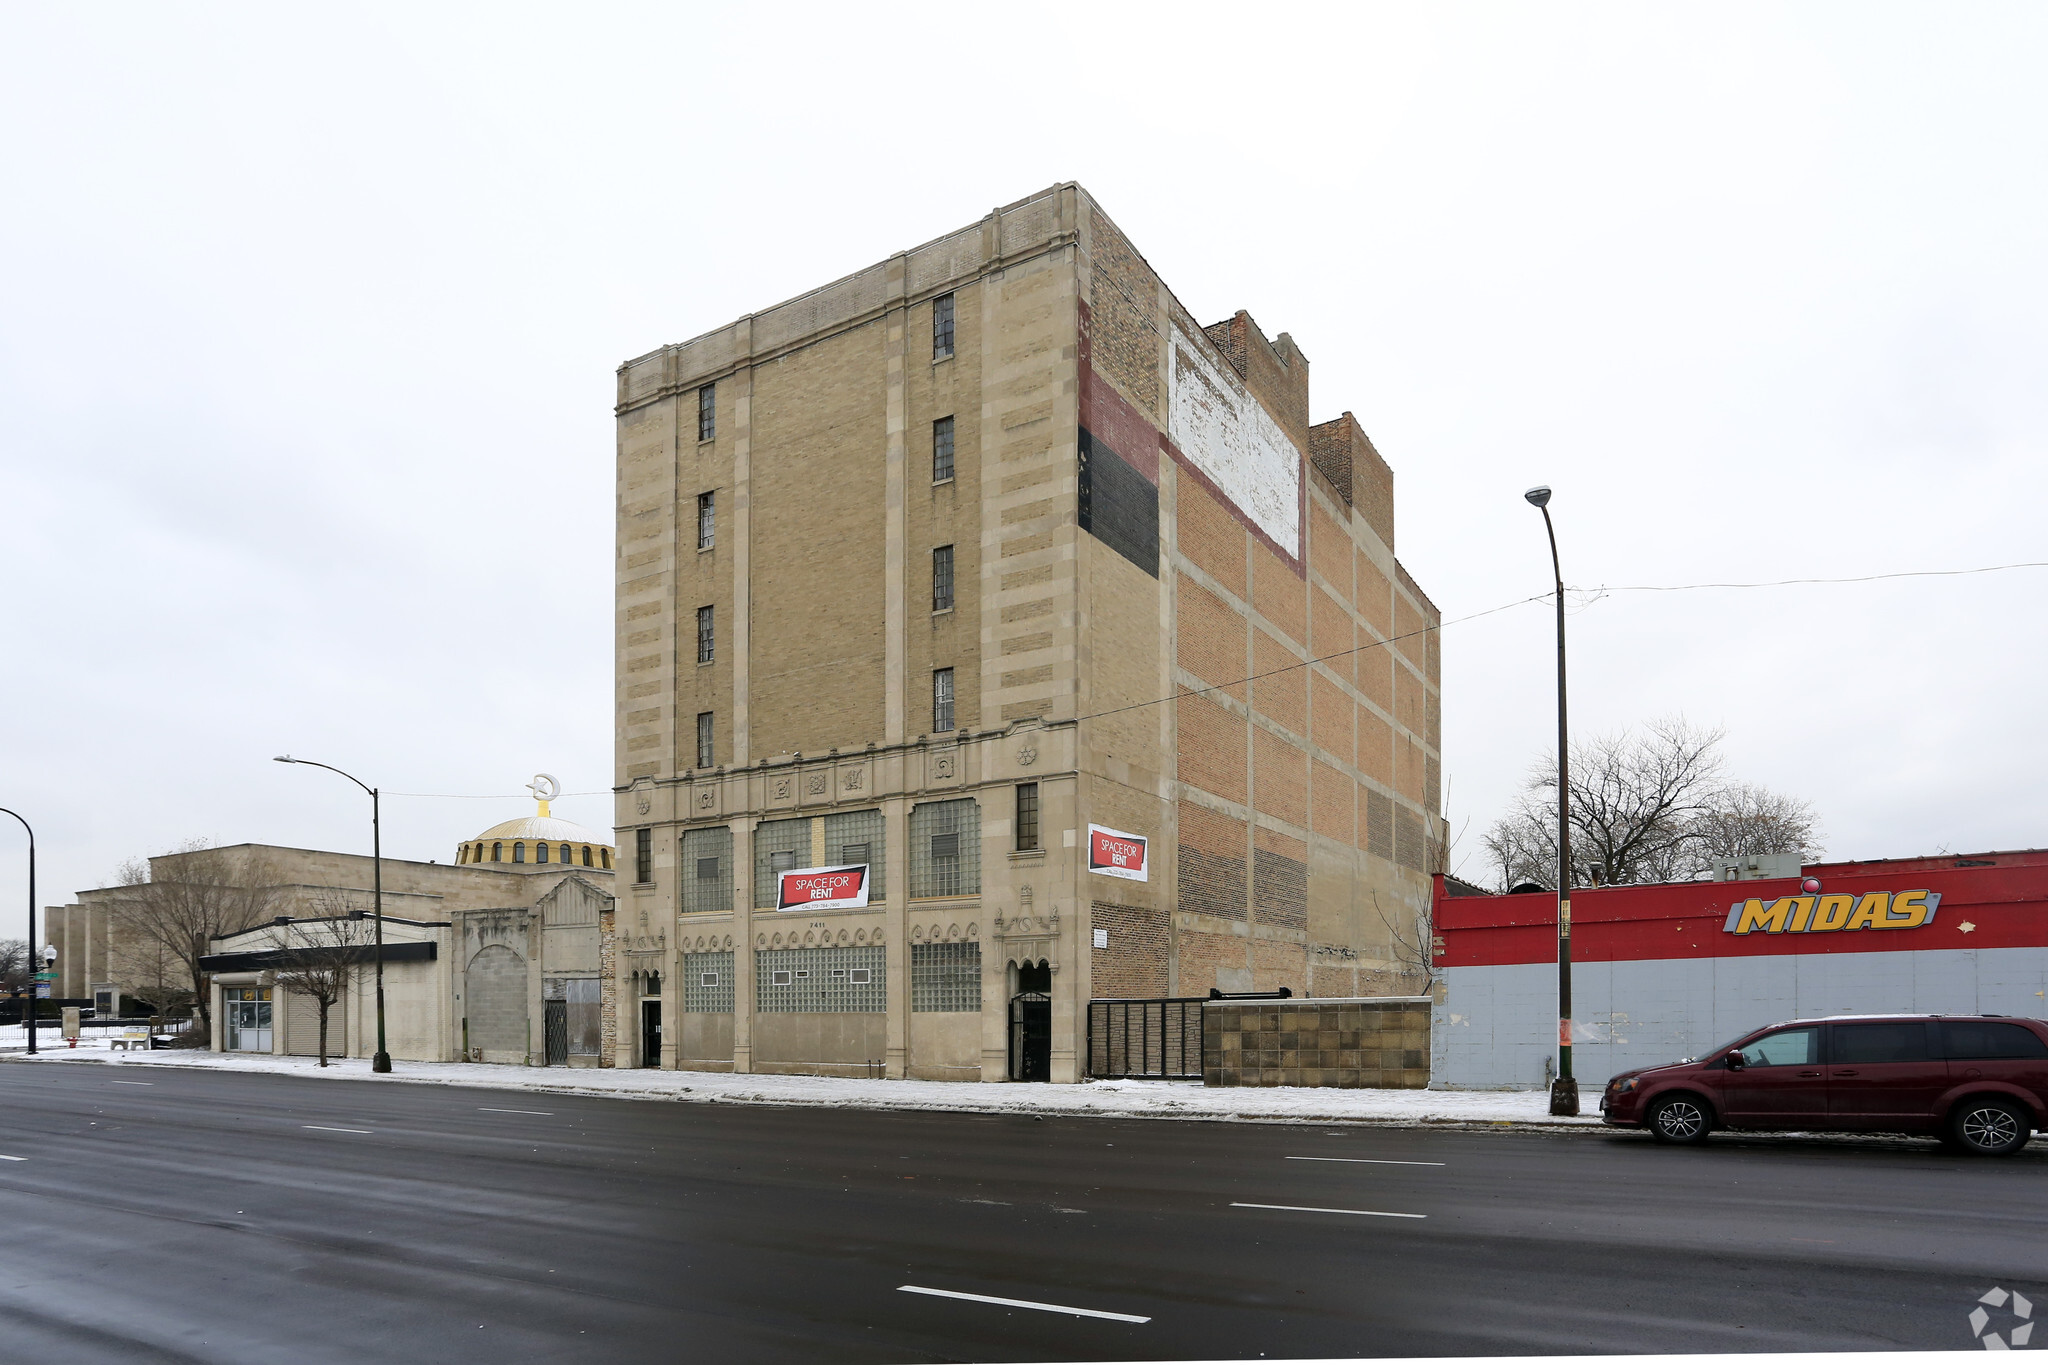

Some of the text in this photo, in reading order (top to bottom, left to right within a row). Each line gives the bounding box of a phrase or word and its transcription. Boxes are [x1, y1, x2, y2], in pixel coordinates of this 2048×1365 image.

[1101, 839, 1136, 857] SPACE FOR
[1112, 853, 1127, 866] RENT
[796, 876, 849, 890] SPACE FOR
[811, 888, 833, 899] RENT
[1734, 879, 1928, 934] MIDAS
